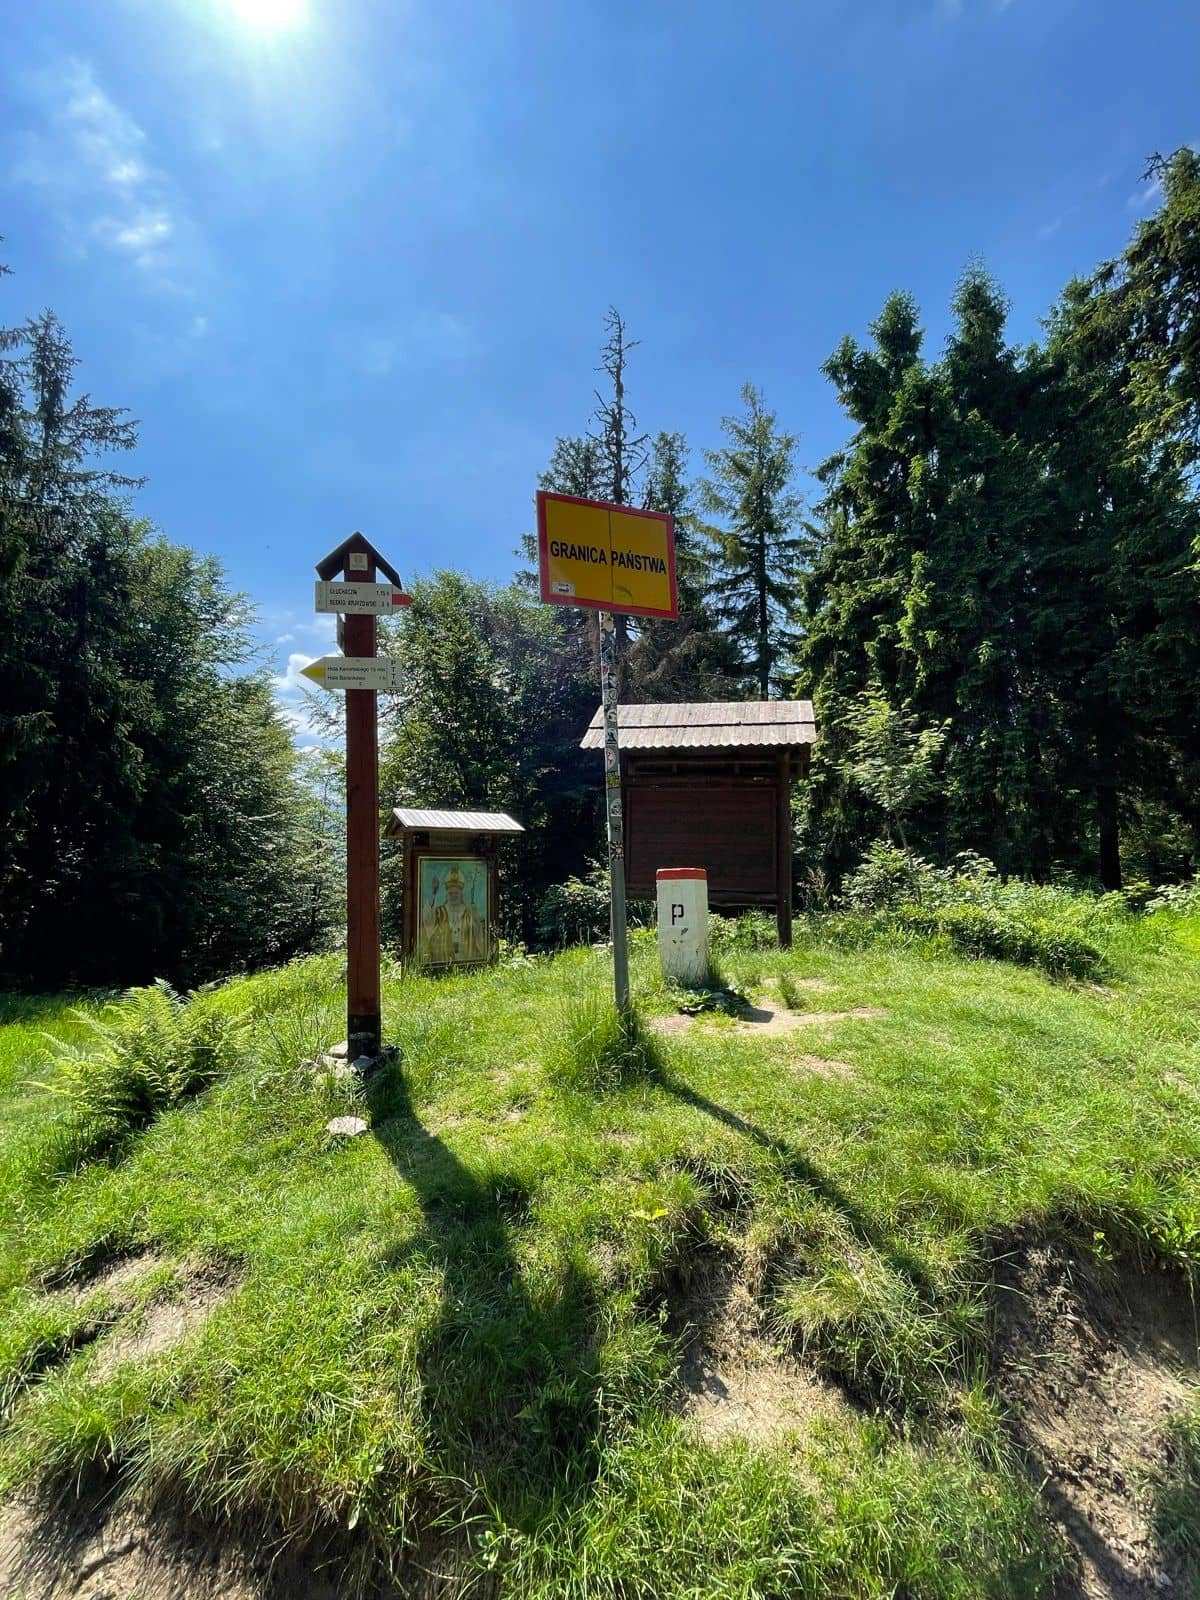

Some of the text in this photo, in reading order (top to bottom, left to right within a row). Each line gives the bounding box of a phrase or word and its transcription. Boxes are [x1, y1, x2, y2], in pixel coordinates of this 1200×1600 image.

[550, 541, 666, 575] GRANICA PAŃSTWA
[671, 903, 684, 926] P
